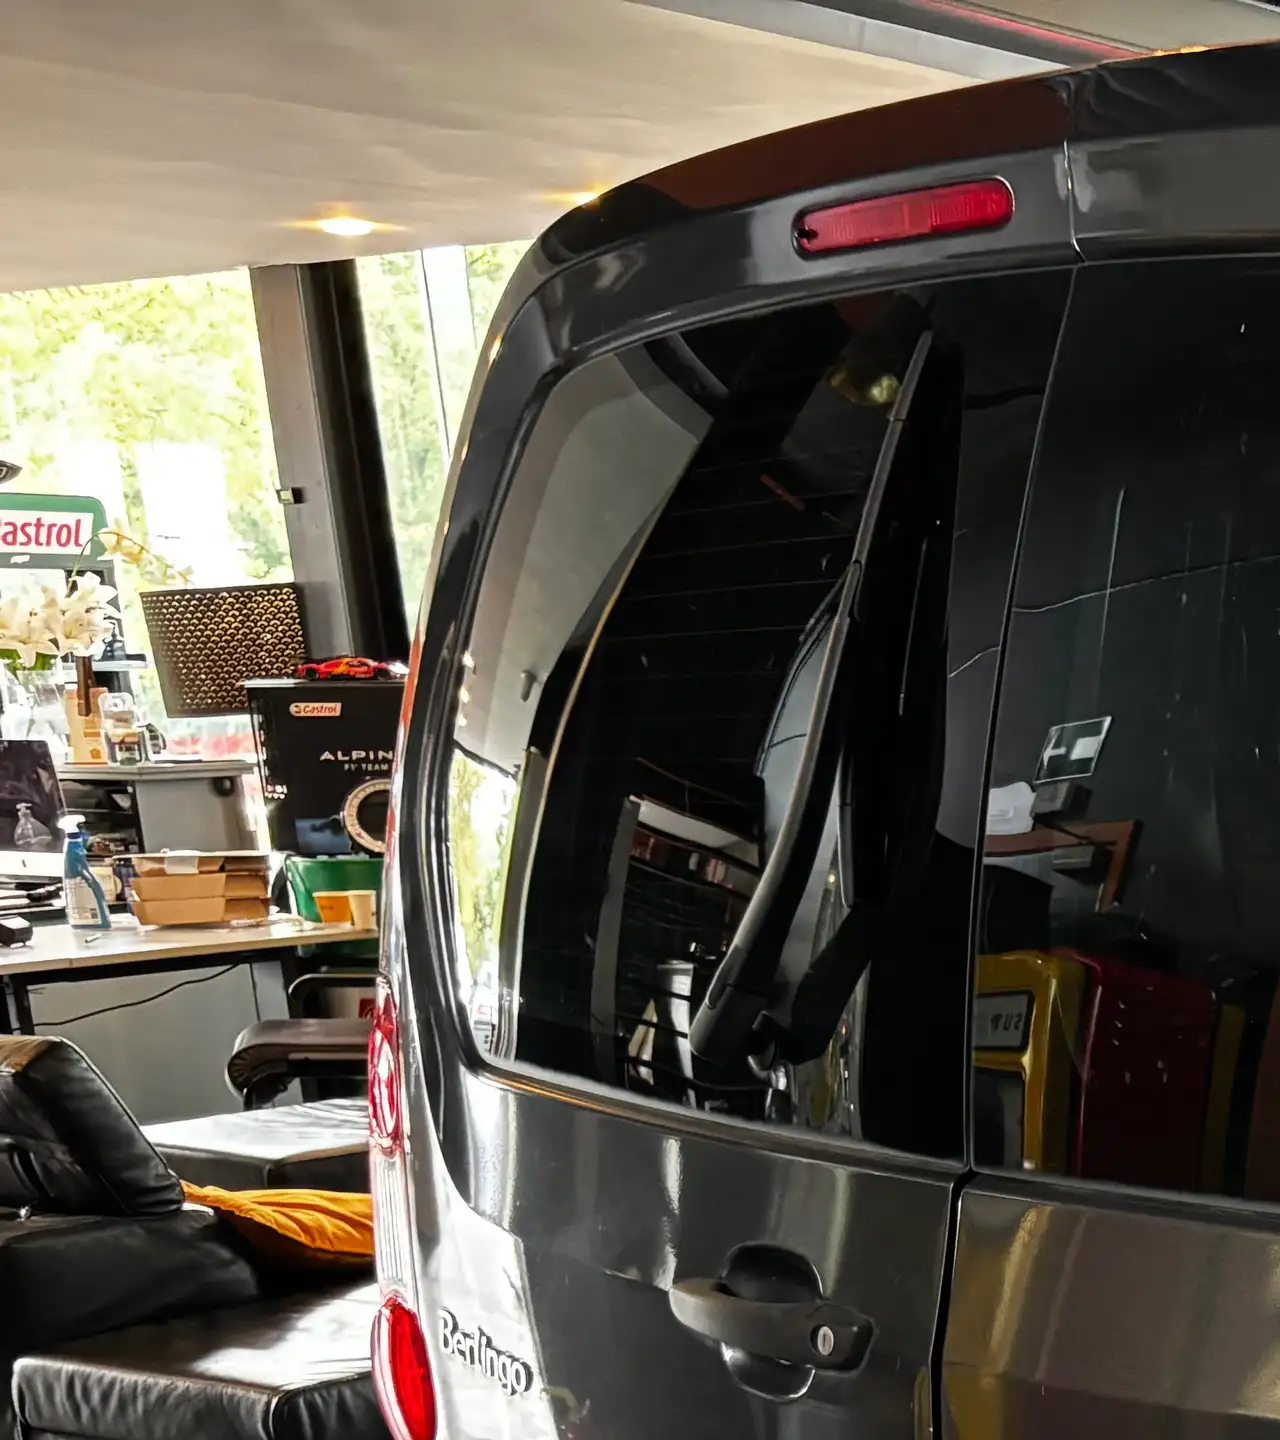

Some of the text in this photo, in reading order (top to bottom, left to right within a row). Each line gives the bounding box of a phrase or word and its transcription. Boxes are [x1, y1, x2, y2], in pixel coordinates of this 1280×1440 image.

[0, 516, 83, 548] astrol
[302, 703, 338, 715] Castrol
[319, 750, 394, 761] ALPIN
[361, 763, 389, 771] TEAM
[438, 1306, 534, 1397] Berlingo
